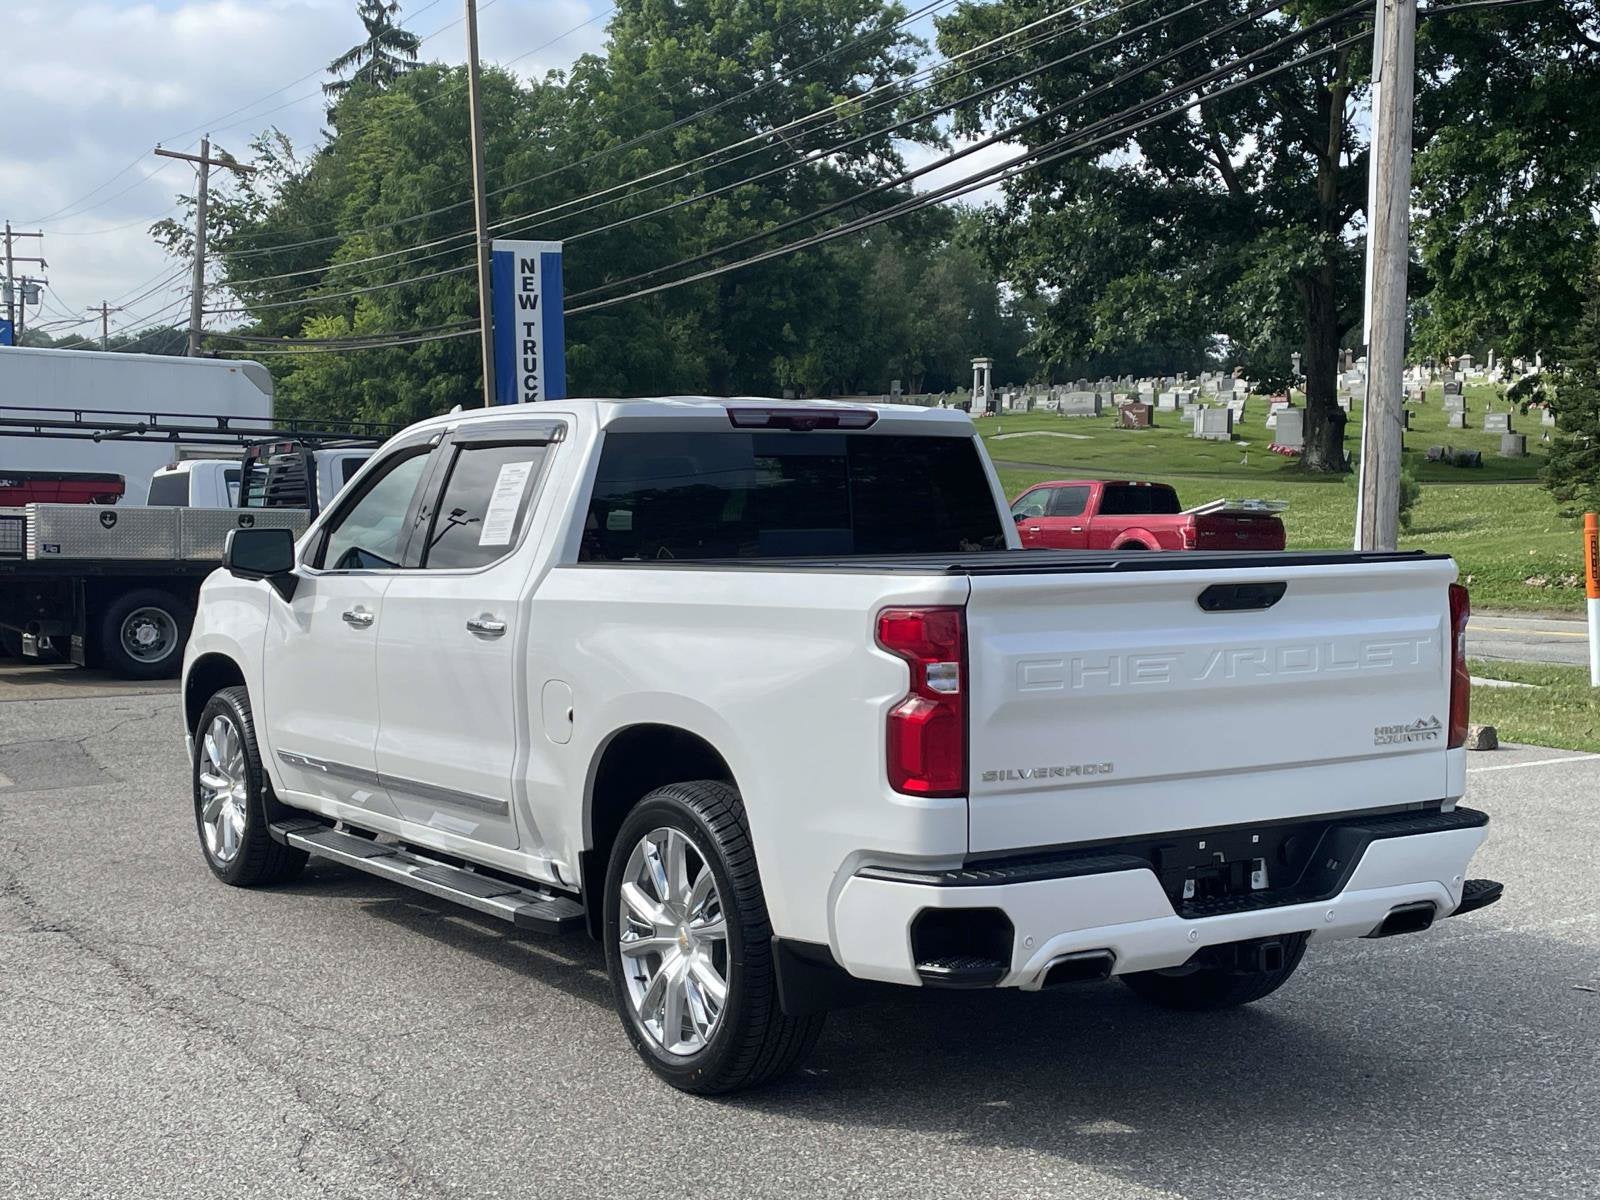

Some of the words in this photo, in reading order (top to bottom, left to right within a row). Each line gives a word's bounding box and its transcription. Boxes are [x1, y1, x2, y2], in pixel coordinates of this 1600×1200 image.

[518, 258, 539, 310] NEW
[523, 322, 539, 403] TRUCK
[1016, 636, 1432, 692] CHEVROLET
[1374, 725, 1411, 736] HIGH
[1374, 731, 1438, 746] COUNTRY
[982, 762, 1114, 782] SILVERADO
